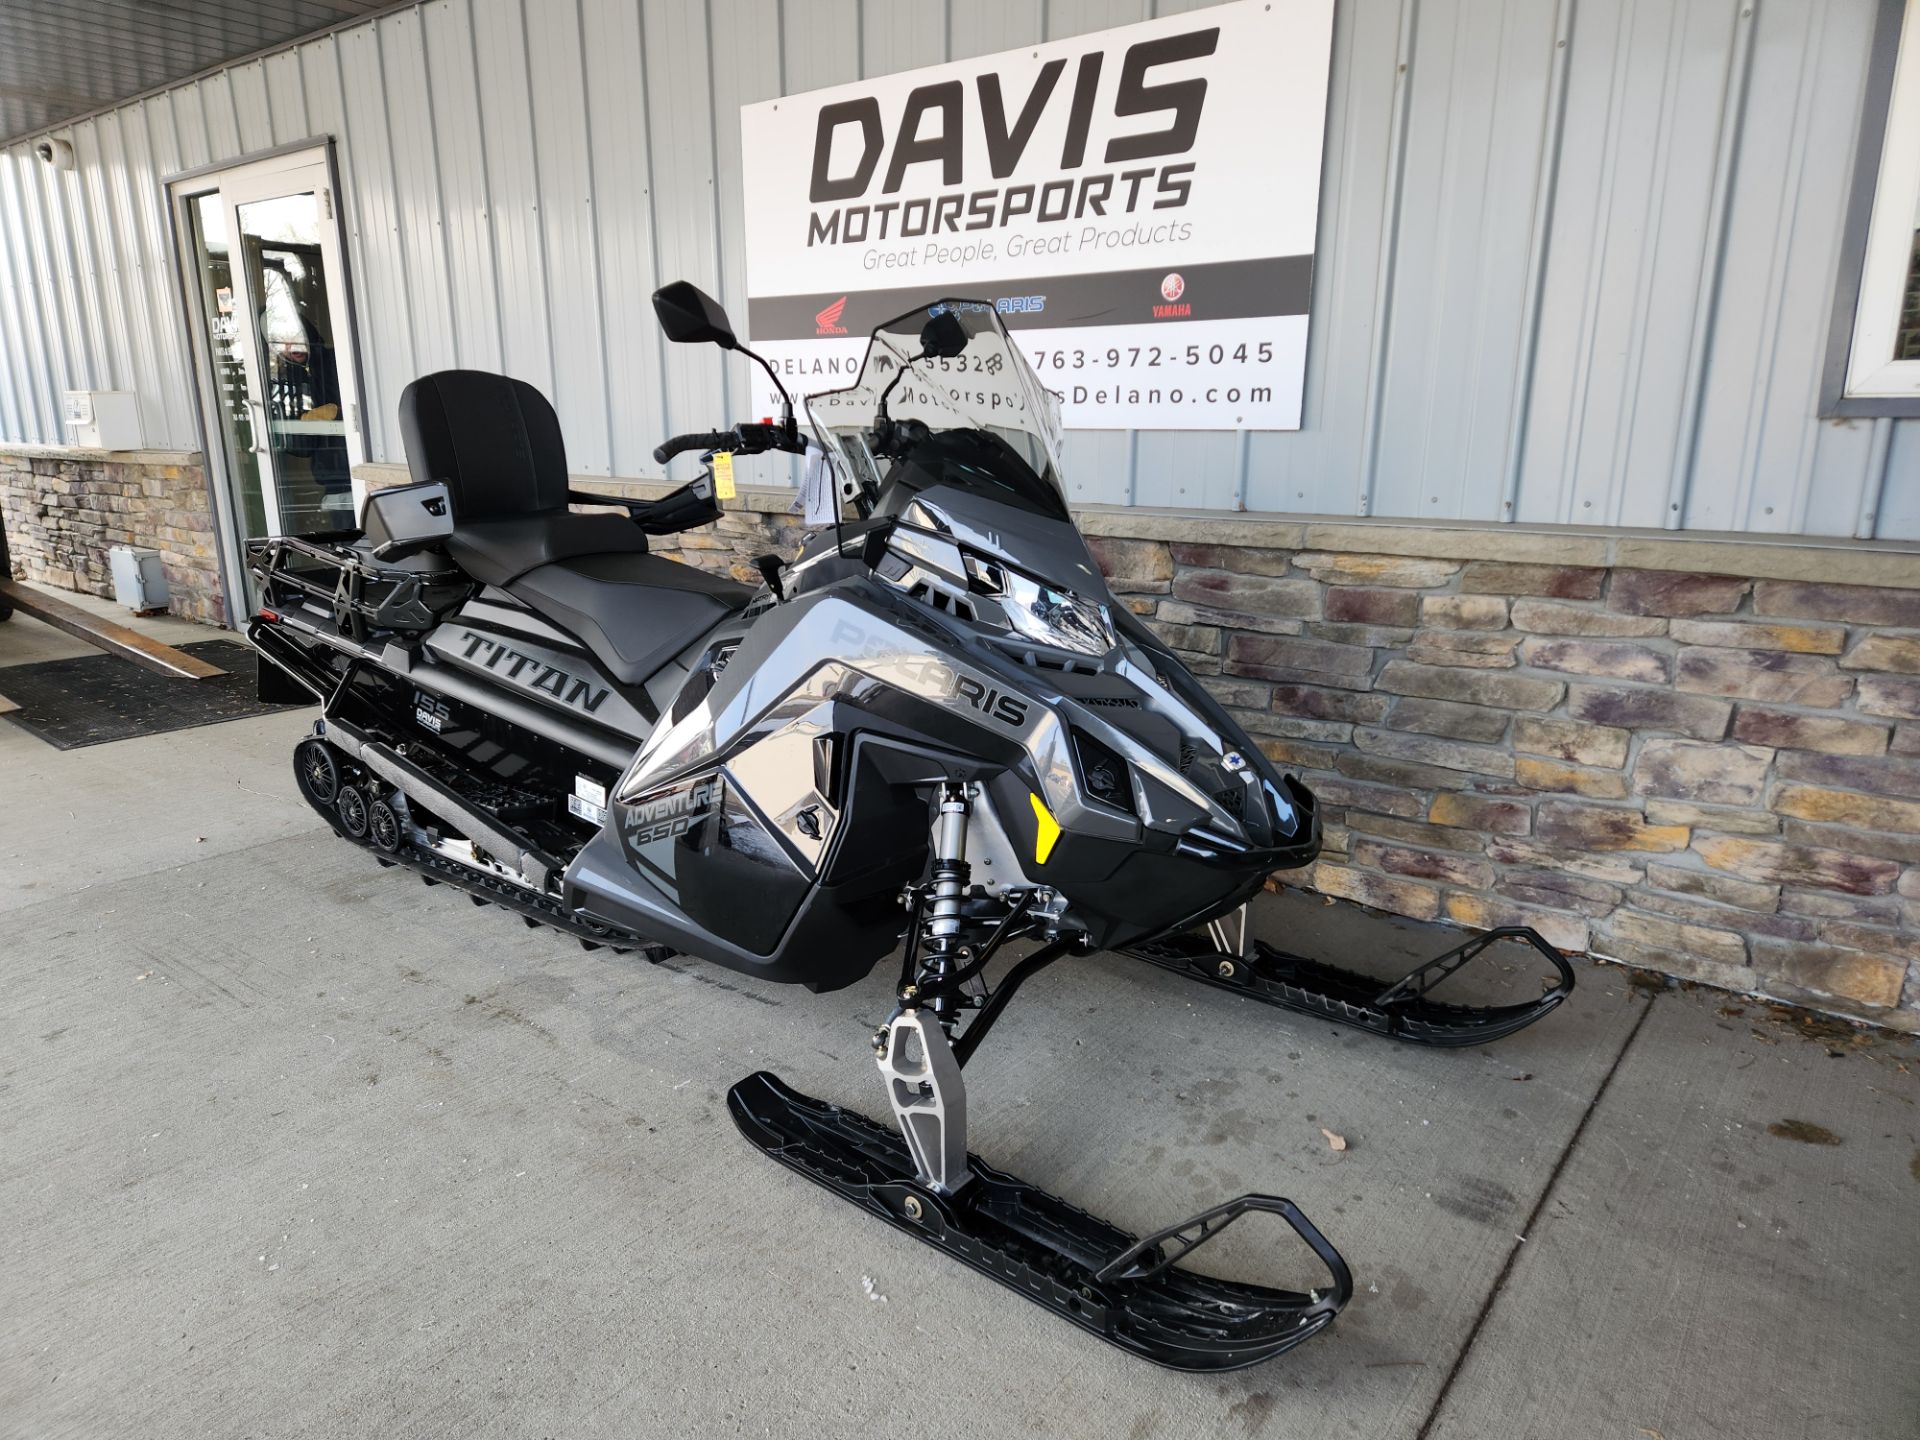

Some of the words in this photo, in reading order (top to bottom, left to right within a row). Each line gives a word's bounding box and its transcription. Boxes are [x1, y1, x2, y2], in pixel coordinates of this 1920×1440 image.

[809, 27, 1221, 203] DAVIS
[807, 162, 1196, 248] MOTORSPORTS
[863, 247, 917, 270] Great
[923, 239, 997, 267] People,
[1007, 231, 1072, 257] Great
[1078, 219, 1193, 251] Products
[815, 326, 848, 335] HONDA
[1152, 303, 1192, 318] YAMAHA
[769, 356, 858, 375] DELANO
[1034, 341, 1273, 370] 763-972-5045
[460, 630, 614, 713] TITAN
[829, 618, 1029, 728] POLARIS
[413, 690, 450, 721] 155
[416, 707, 442, 728] DAVIS
[624, 778, 723, 830] ADVENTURE
[636, 815, 690, 847] 650
